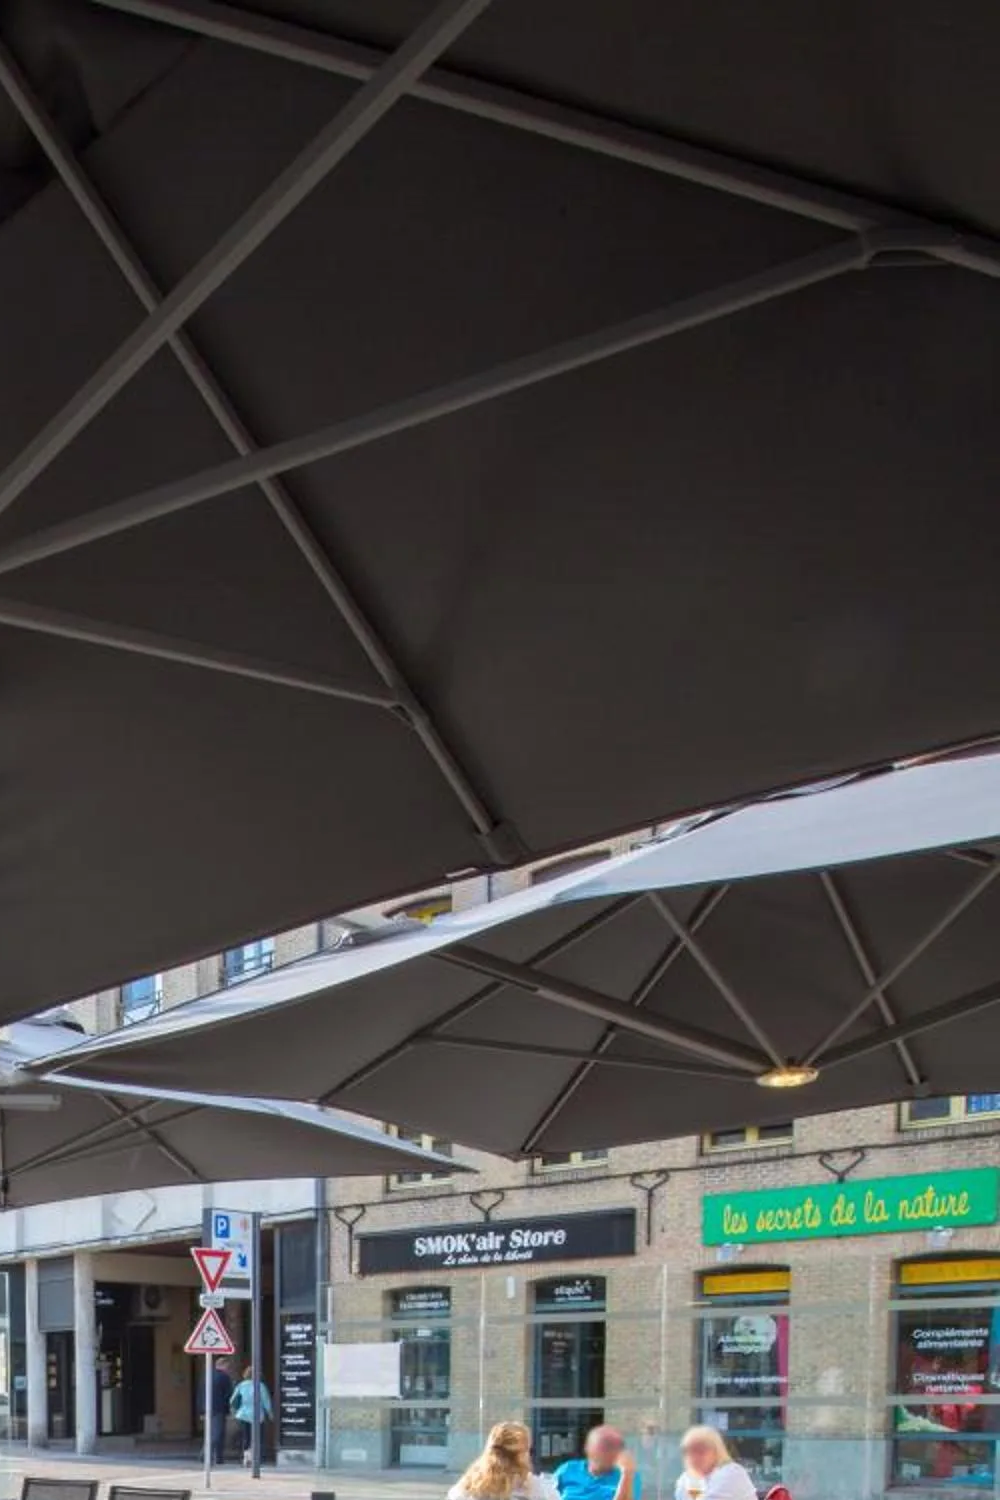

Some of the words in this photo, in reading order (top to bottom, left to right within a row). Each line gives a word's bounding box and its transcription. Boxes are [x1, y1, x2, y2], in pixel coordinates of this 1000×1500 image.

[722, 1203, 748, 1235] les
[755, 1197, 822, 1232] secrets
[830, 1194, 857, 1226] de
[863, 1189, 889, 1222] la
[898, 1184, 970, 1219] nature
[414, 1231, 505, 1257] SMOK'air
[509, 1228, 567, 1249] Store
